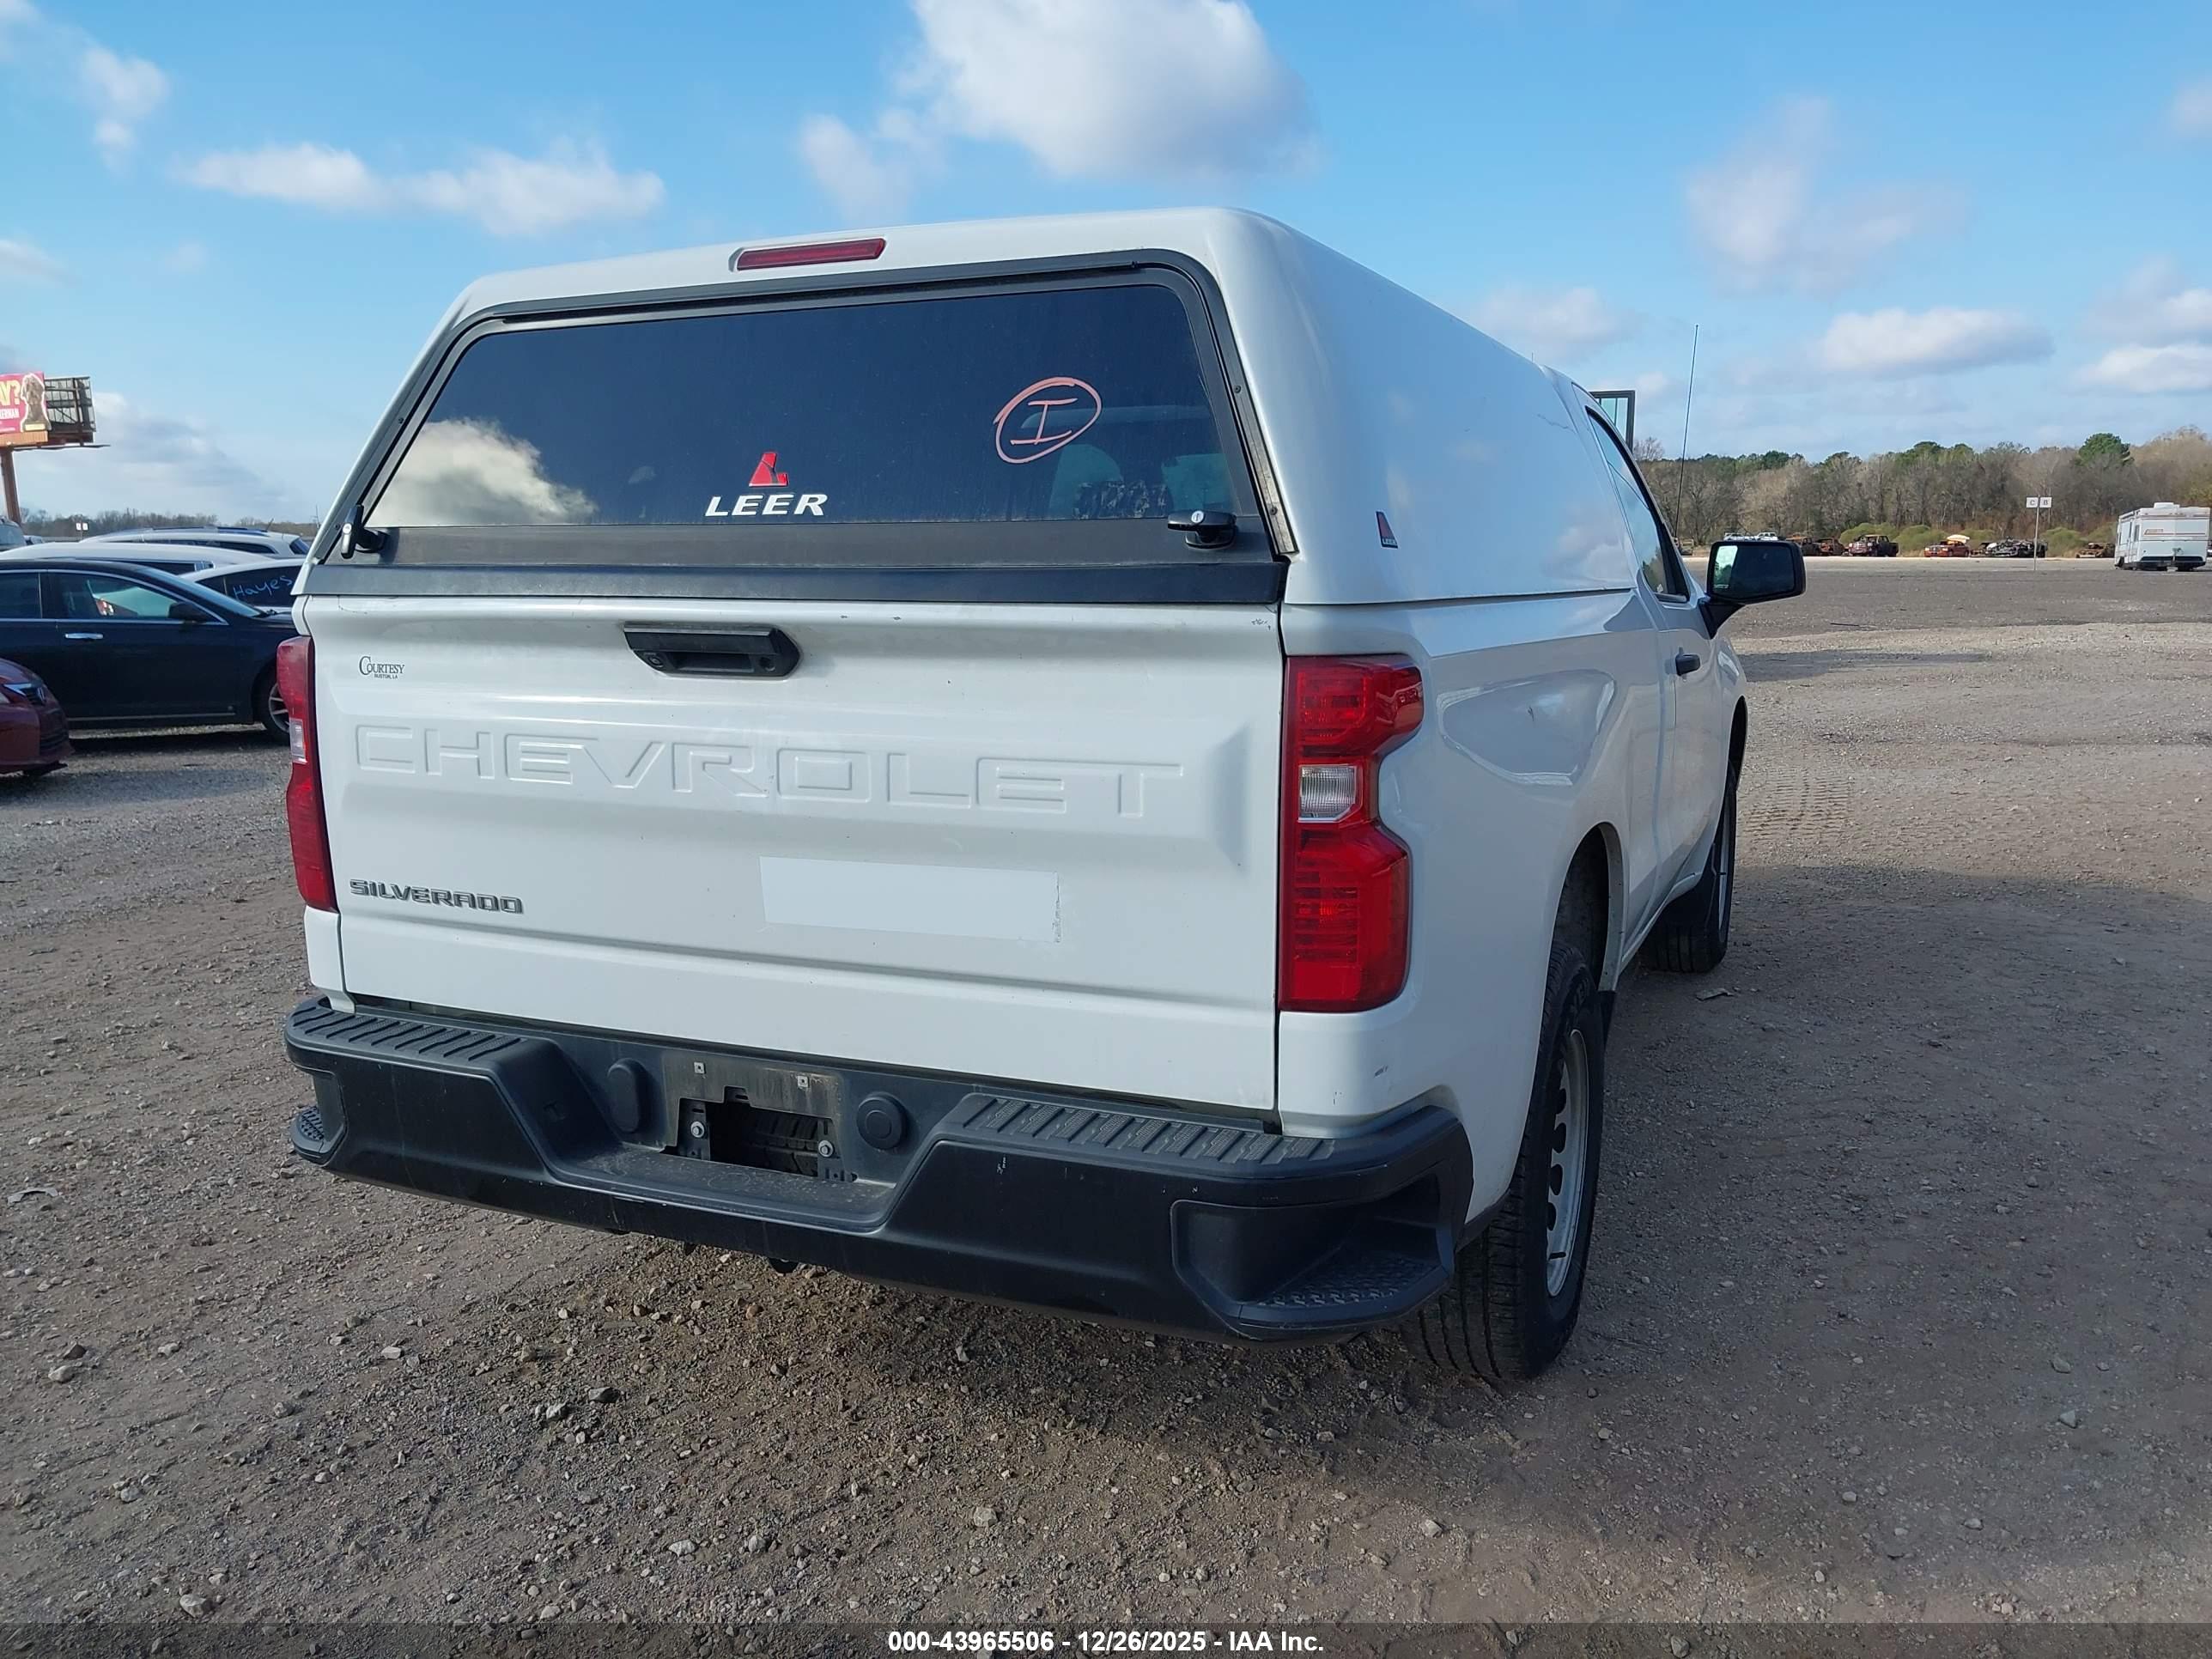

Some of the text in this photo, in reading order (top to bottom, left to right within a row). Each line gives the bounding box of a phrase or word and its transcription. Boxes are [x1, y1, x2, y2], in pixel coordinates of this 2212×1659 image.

[704, 494, 829, 517] LEER
[233, 575, 294, 601] Hayes
[359, 655, 405, 676] COURTESY
[356, 724, 1185, 818] CHEVROLET
[349, 878, 525, 915] SILVERADO
